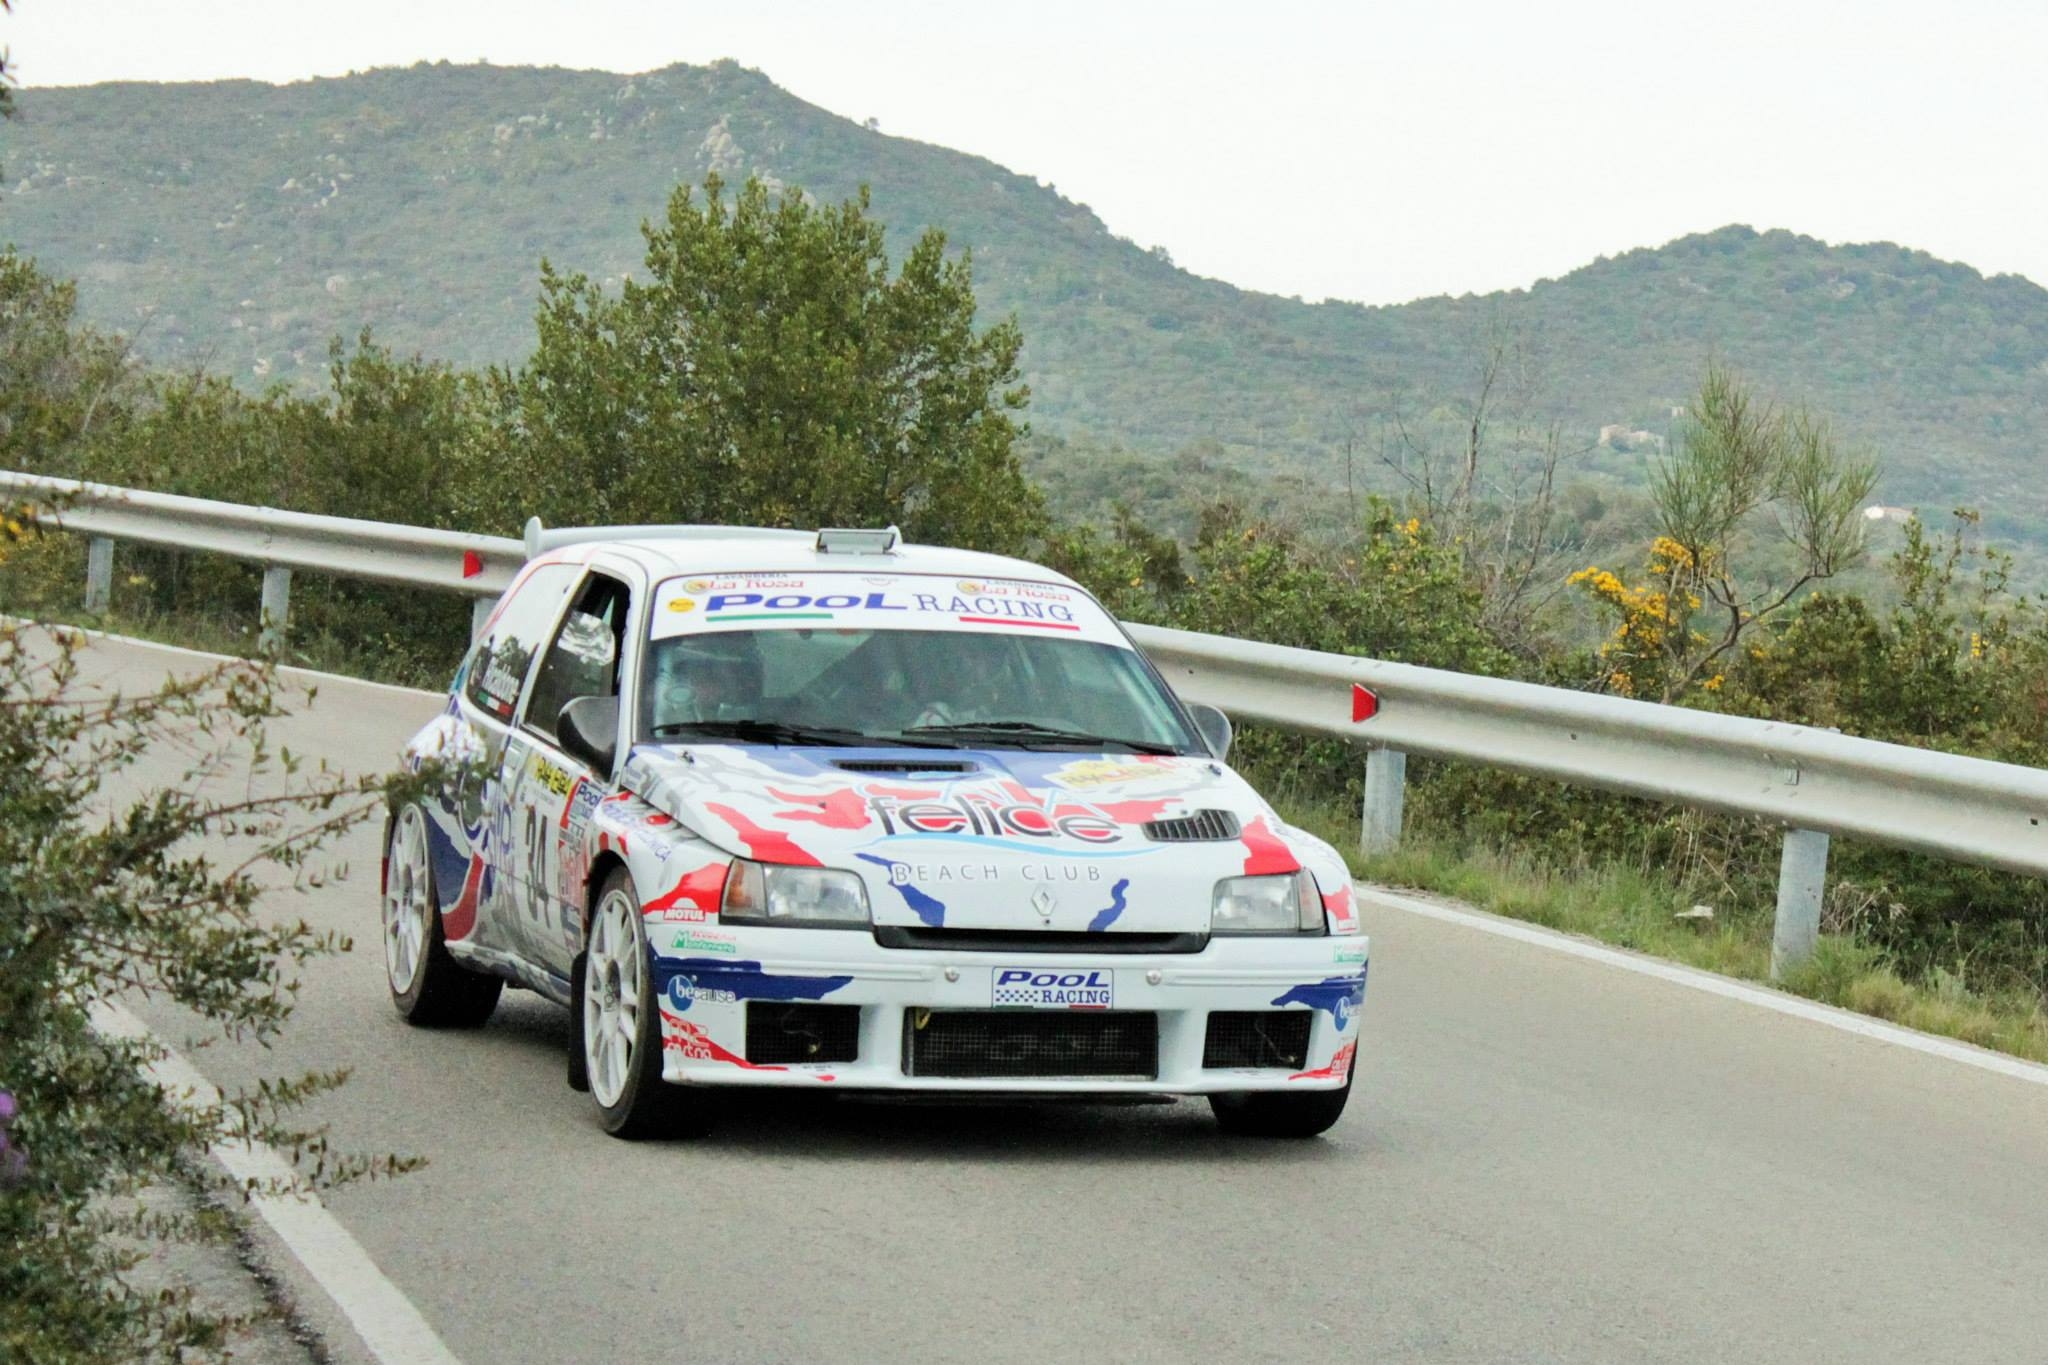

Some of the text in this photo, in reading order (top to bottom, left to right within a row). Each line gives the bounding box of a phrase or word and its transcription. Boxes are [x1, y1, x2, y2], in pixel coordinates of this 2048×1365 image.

[911, 593, 1074, 622] RACING
[869, 794, 1123, 844] felice
[894, 864, 1102, 883] BEACH CLUB
[664, 908, 705, 921] MOTUL
[1041, 989, 1111, 1004] RACING
